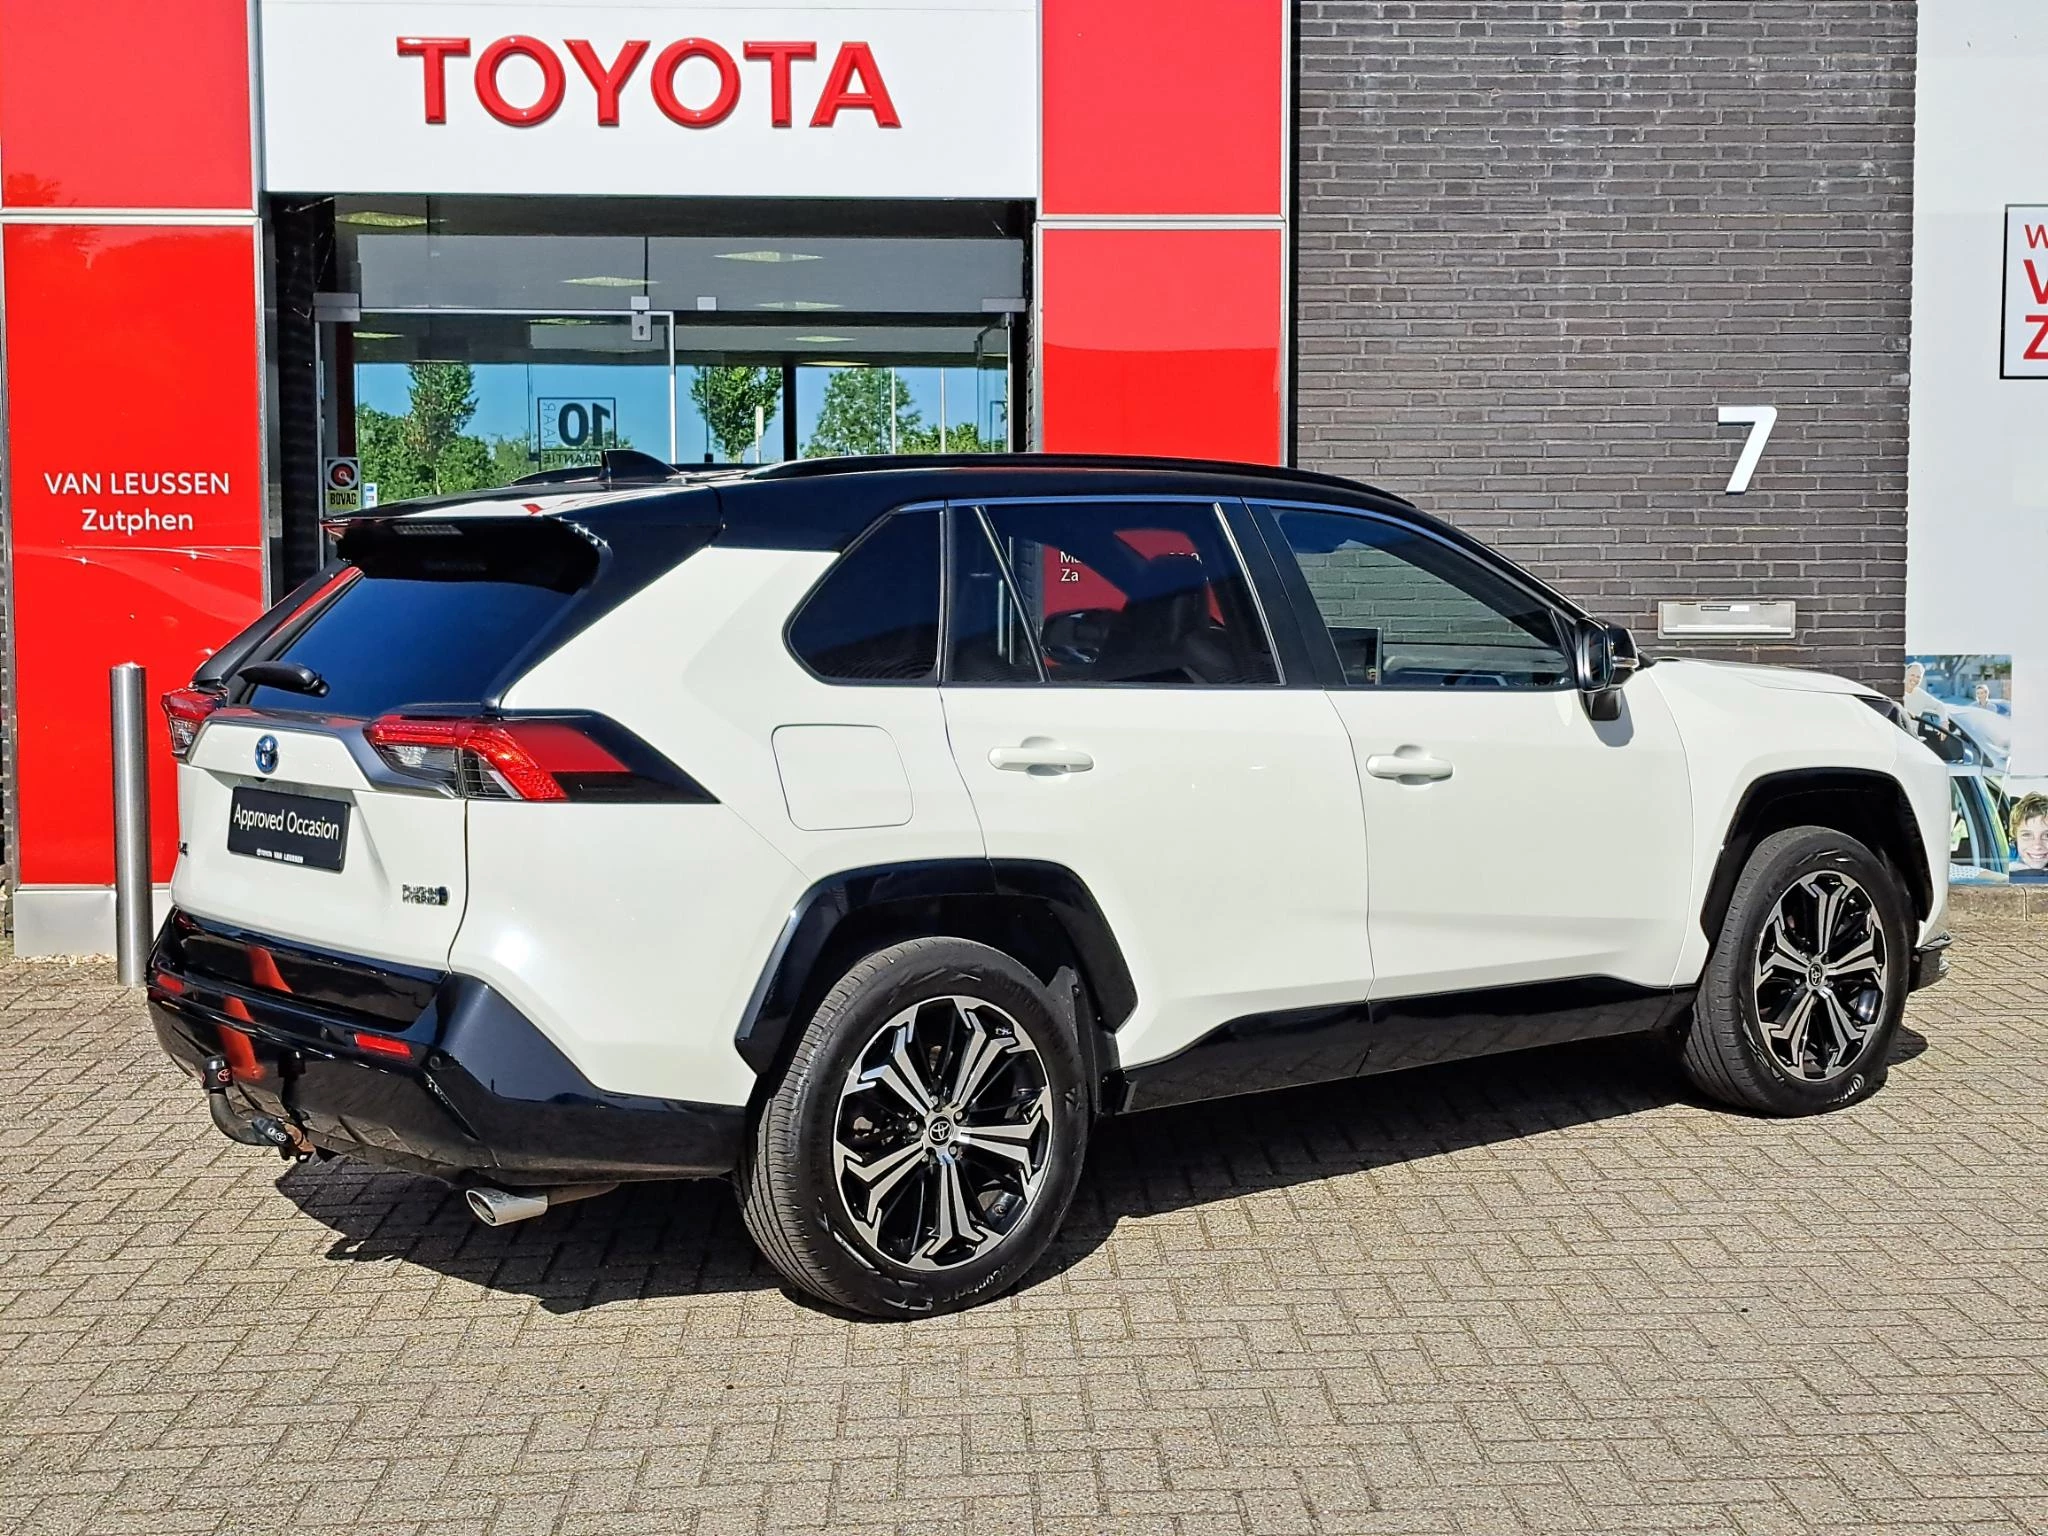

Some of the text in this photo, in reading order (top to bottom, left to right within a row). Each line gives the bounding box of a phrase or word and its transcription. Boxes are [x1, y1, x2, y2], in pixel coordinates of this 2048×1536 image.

[396, 34, 902, 129] TOYOTA
[1717, 406, 1777, 495] 7
[44, 472, 230, 495] VAN LEUSSEN
[330, 493, 357, 505] BOVAG
[82, 508, 193, 535] Zutphen
[1061, 569, 1079, 582] Za
[233, 802, 339, 841] Approved Occasion
